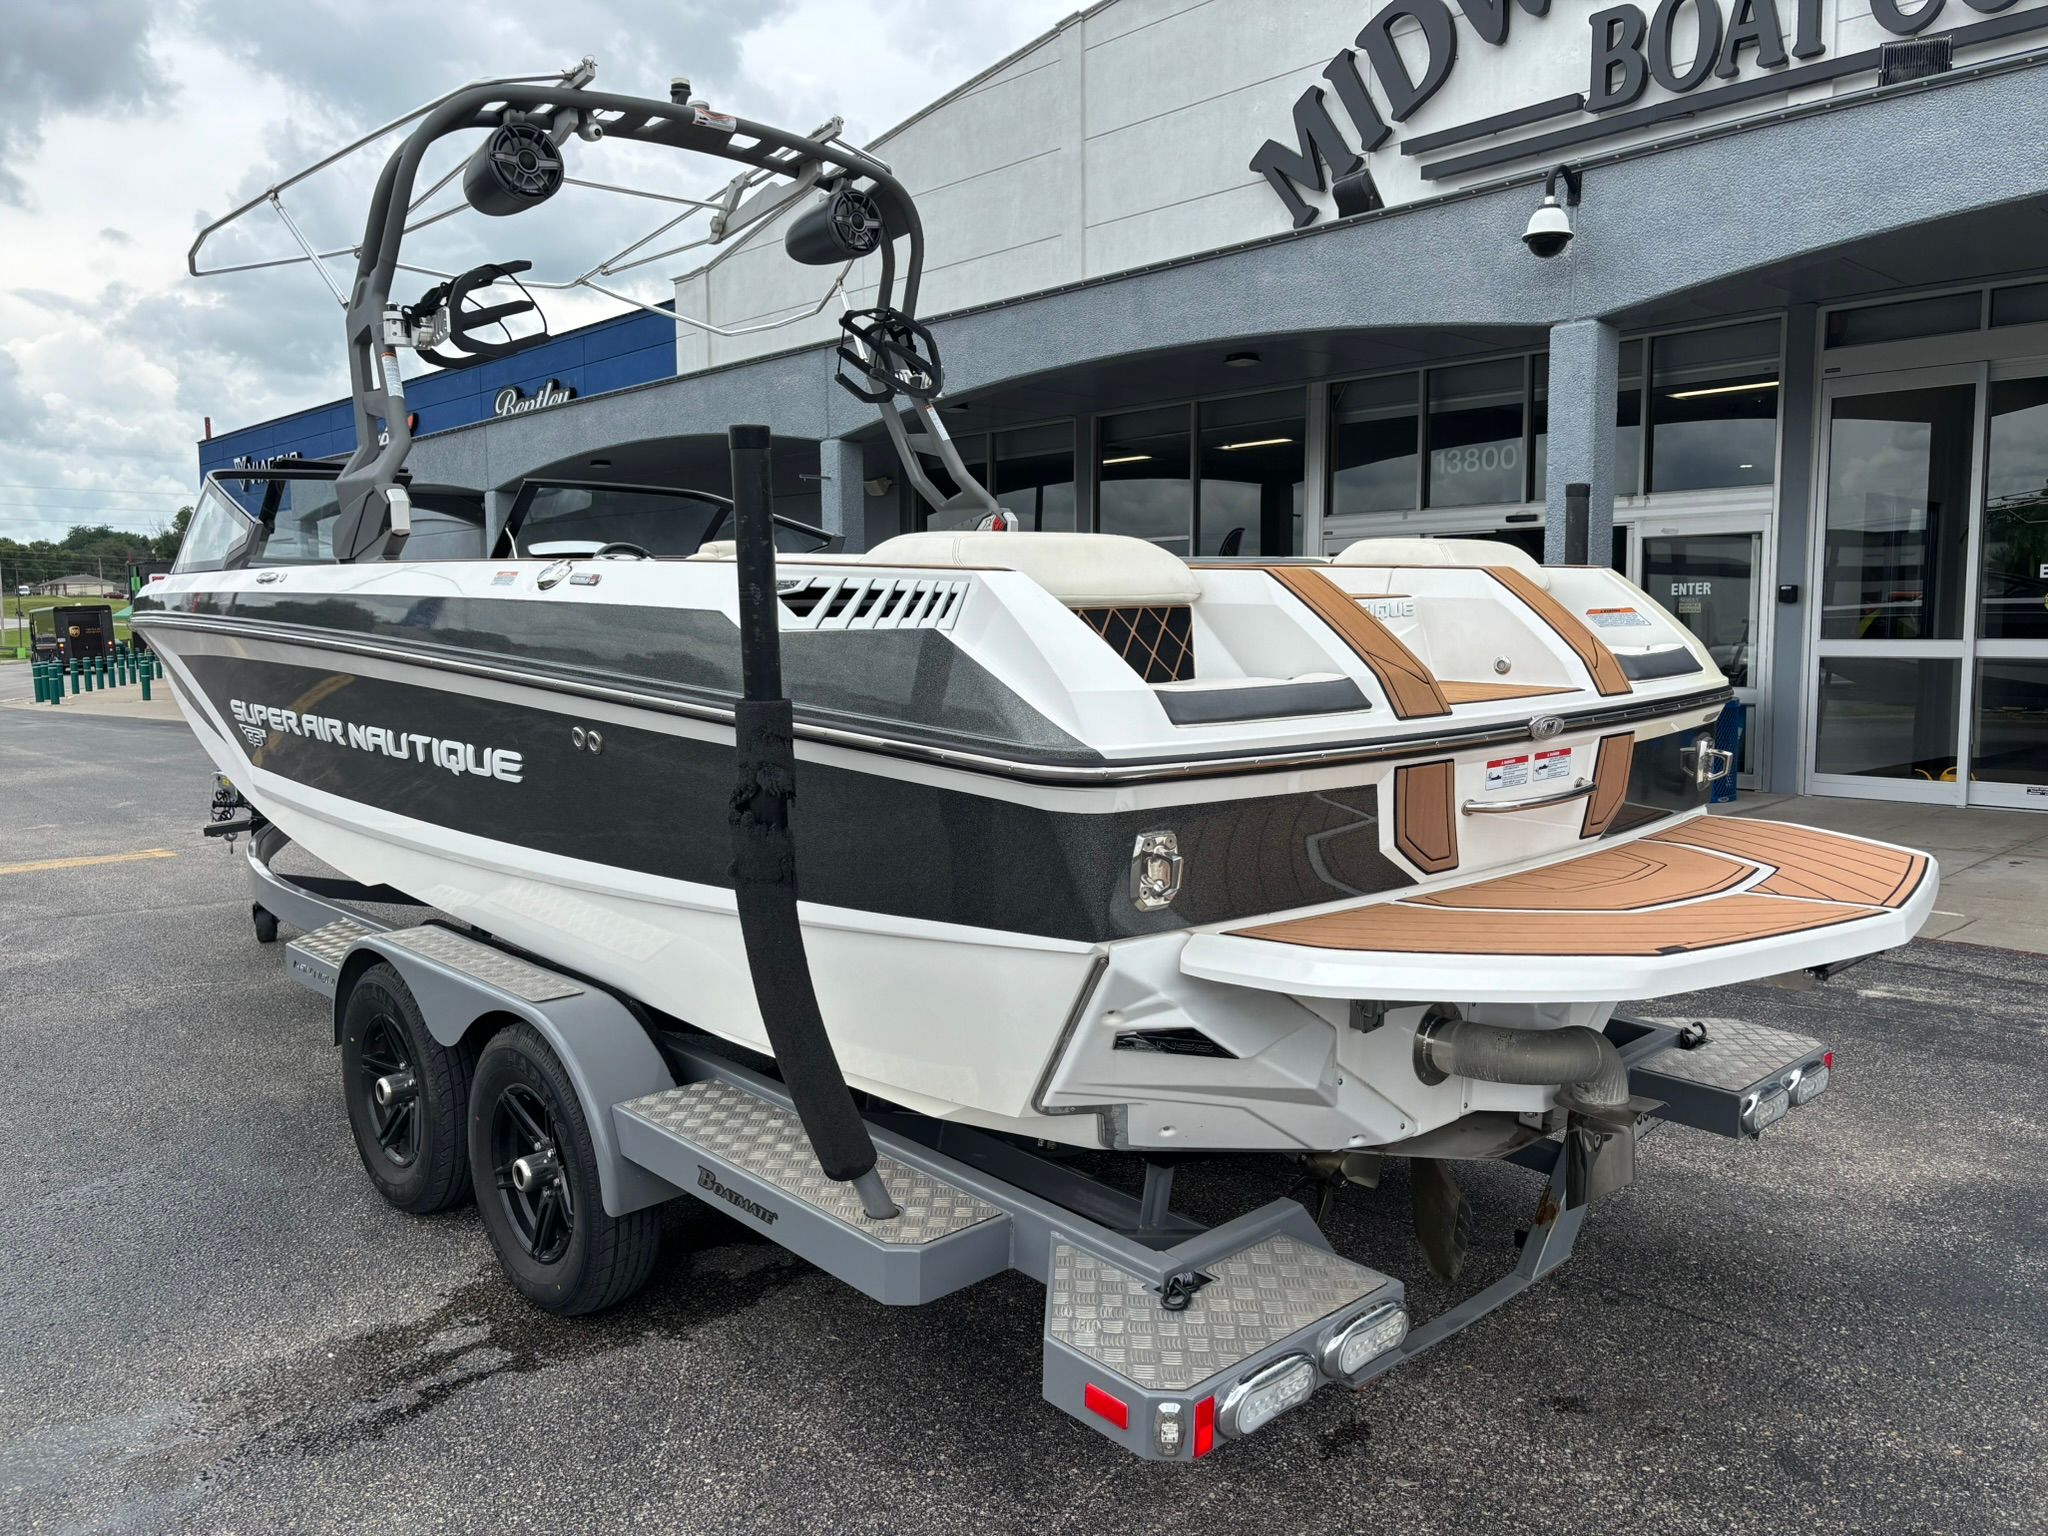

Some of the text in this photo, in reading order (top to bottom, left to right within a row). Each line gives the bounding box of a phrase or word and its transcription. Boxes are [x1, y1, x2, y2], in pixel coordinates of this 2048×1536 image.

[1437, 445, 1517, 475] 13800
[1671, 582, 1711, 596] ENTER
[230, 698, 525, 784] SUPER AIR NAUTIQUE
